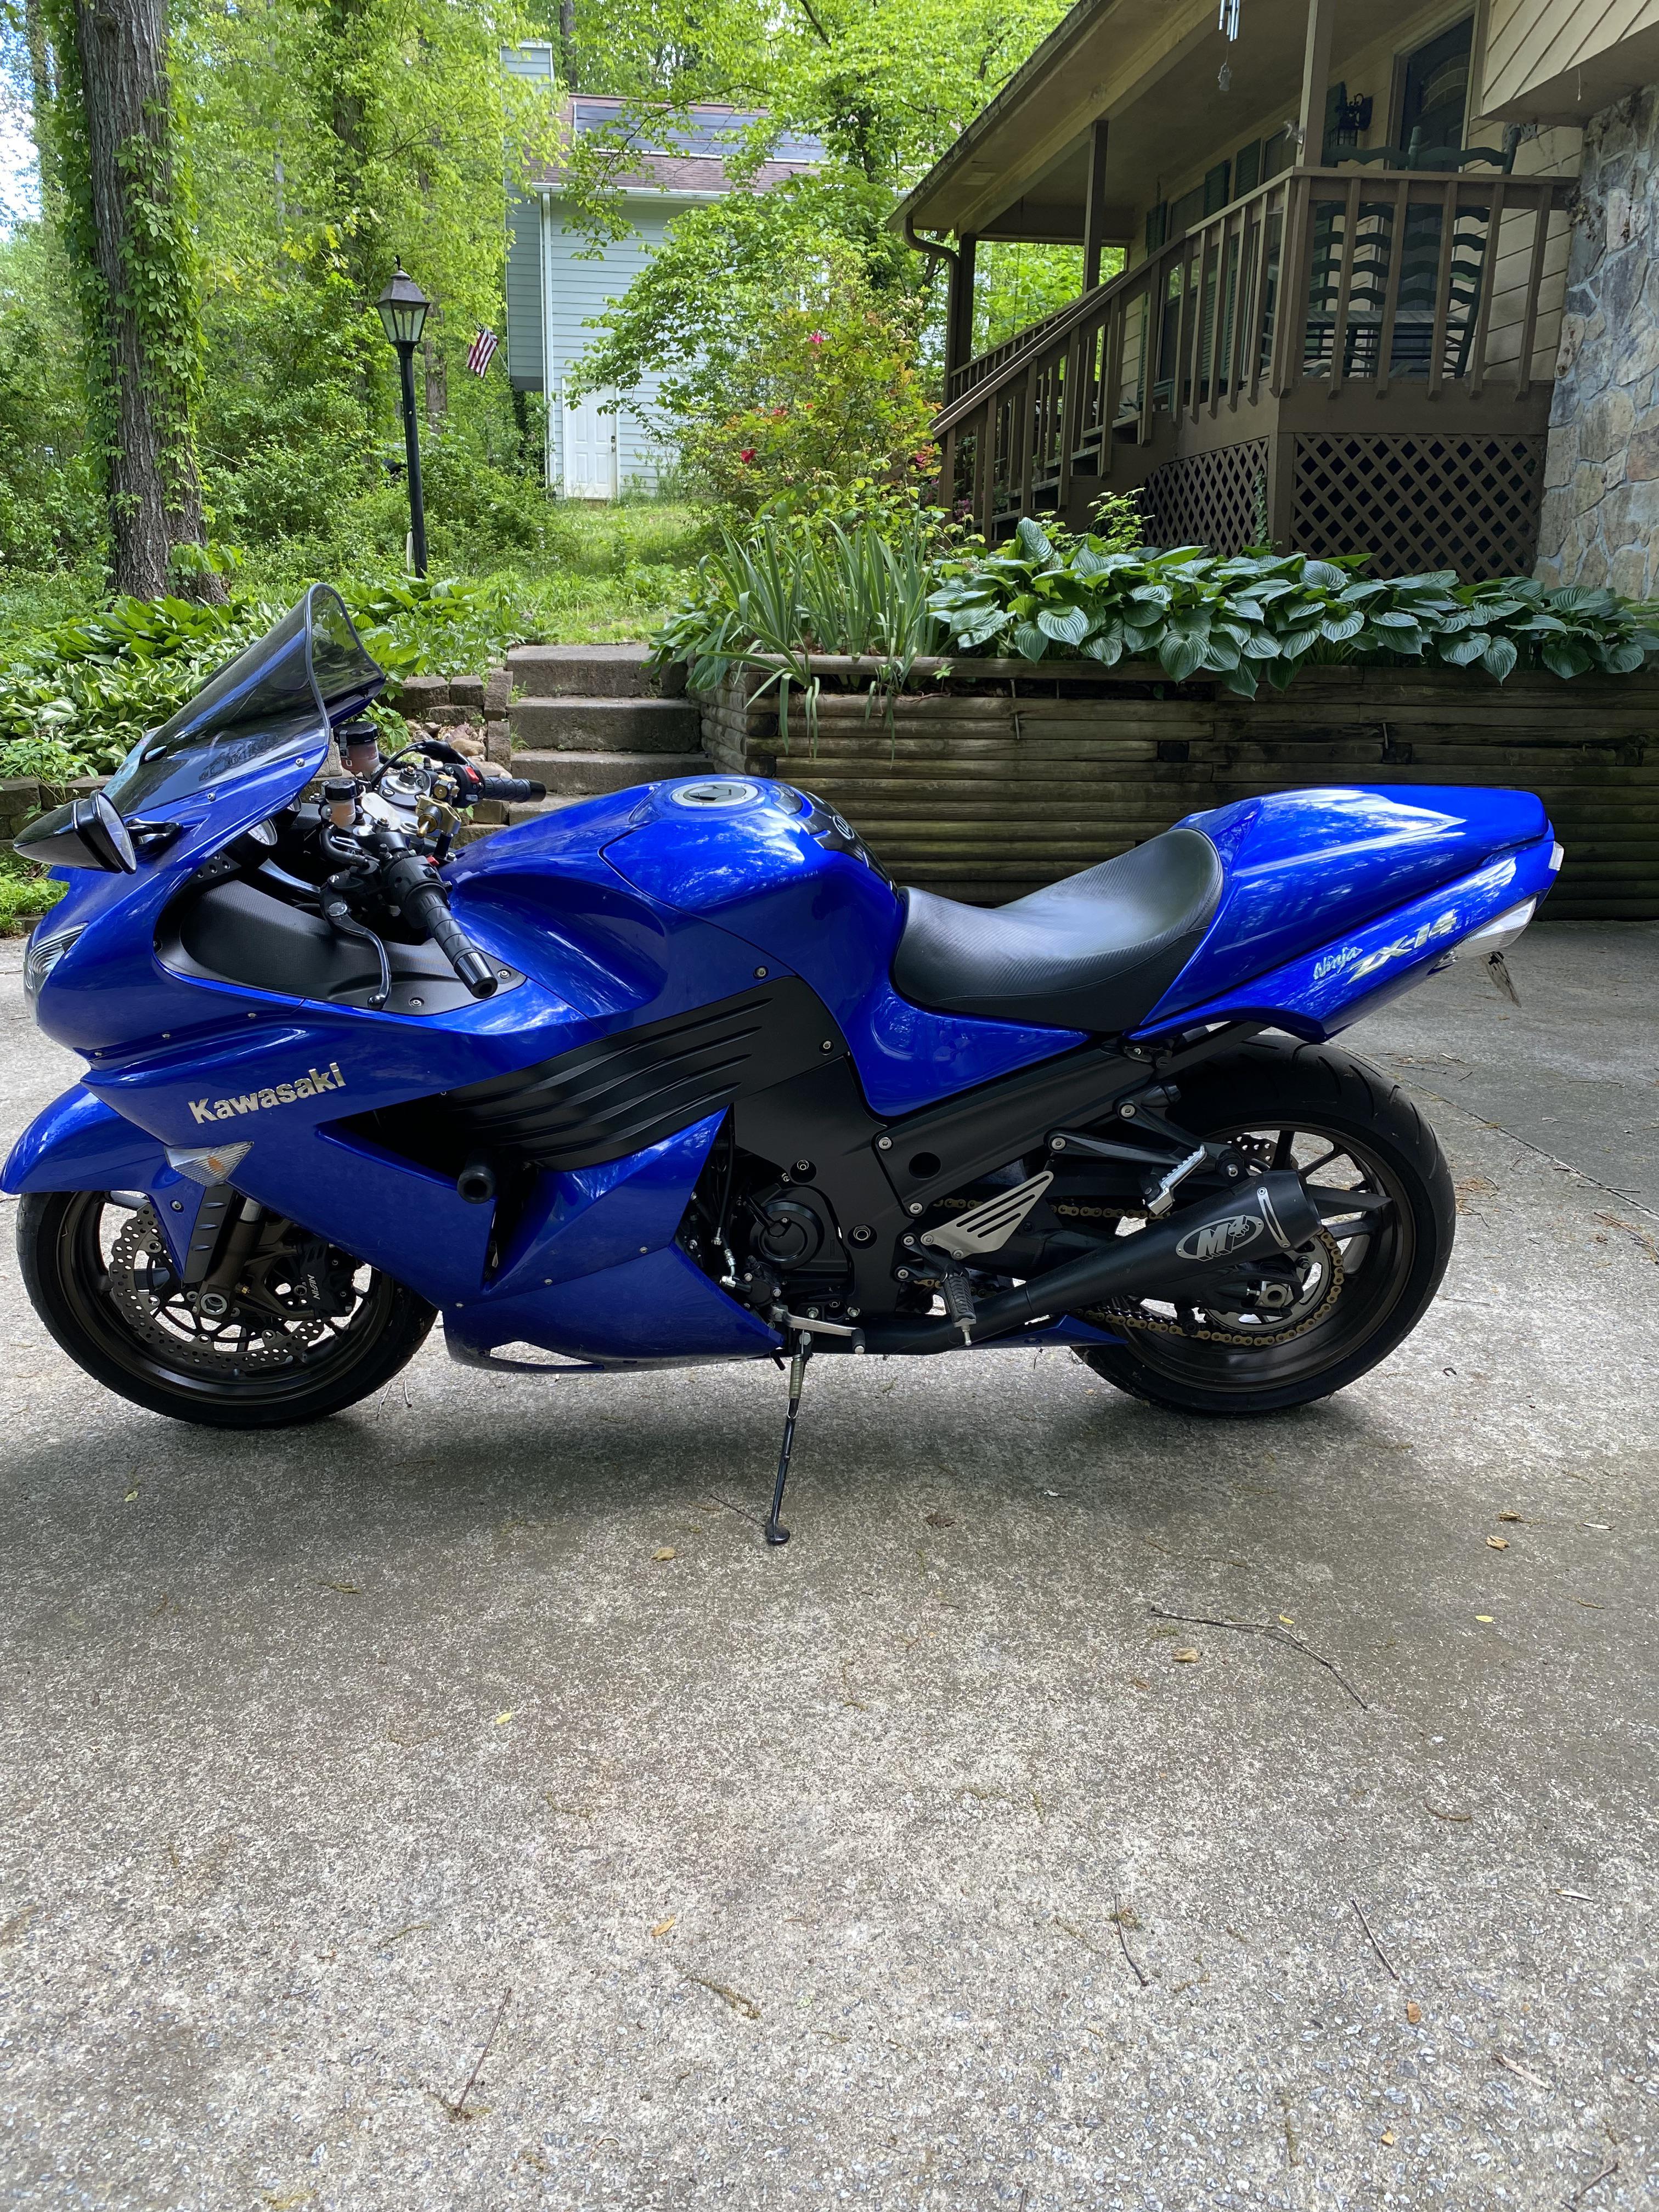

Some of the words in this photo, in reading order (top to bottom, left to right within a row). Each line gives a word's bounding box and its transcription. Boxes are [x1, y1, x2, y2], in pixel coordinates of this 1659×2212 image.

[1313, 946, 1363, 980] Ninja
[1346, 909, 1458, 985] ZX-14
[188, 1062, 346, 1124] Kawasaki
[1196, 1215, 1250, 1262] M4
